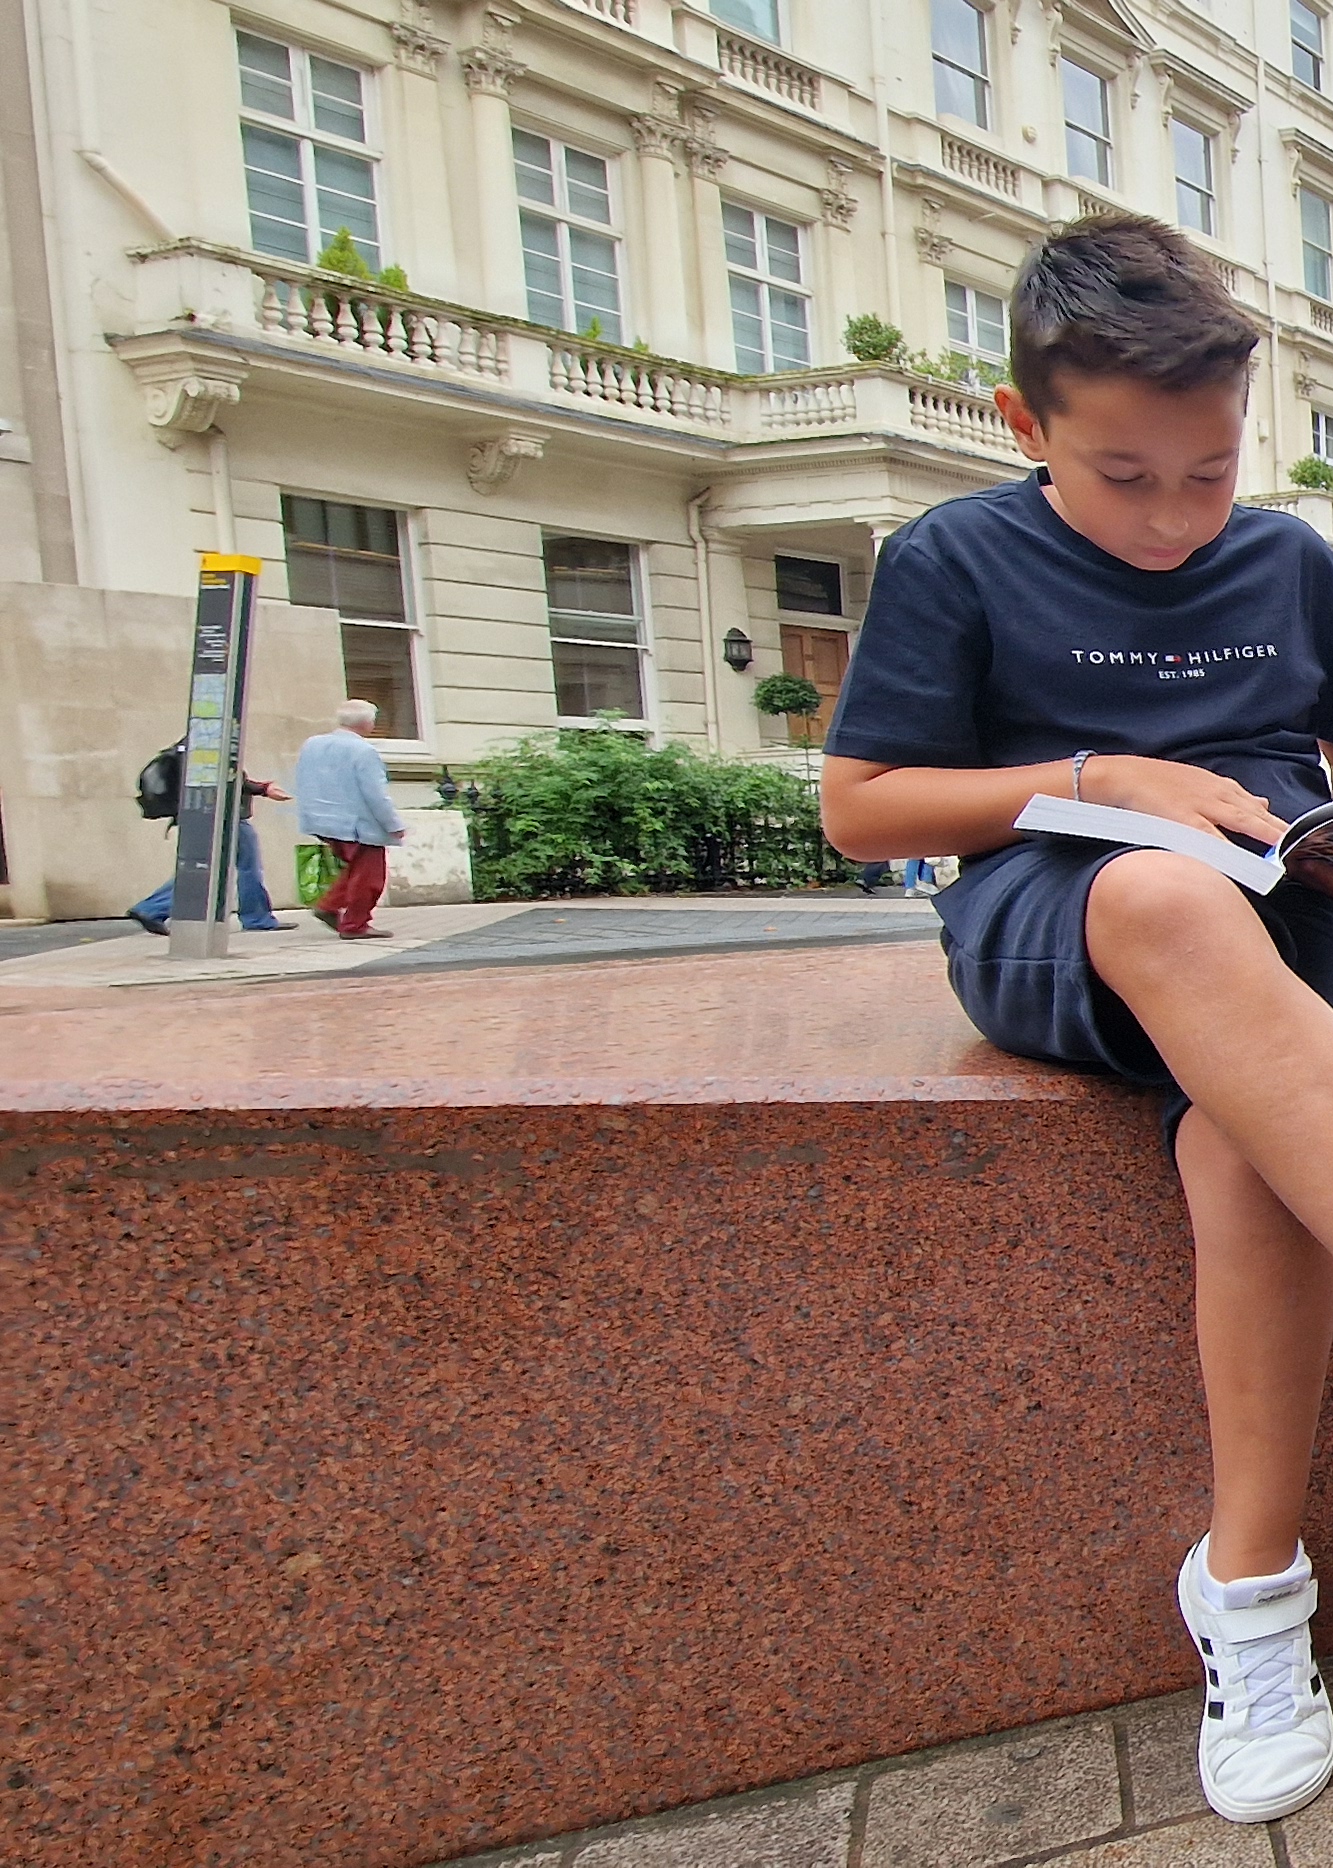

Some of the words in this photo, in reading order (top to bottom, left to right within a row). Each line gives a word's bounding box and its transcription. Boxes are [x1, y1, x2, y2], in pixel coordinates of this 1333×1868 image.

[1071, 650, 1159, 665] TOMMY
[1188, 644, 1279, 665] HILFIGER
[1158, 669, 1180, 679] EST.
[1181, 668, 1206, 679] 1985
